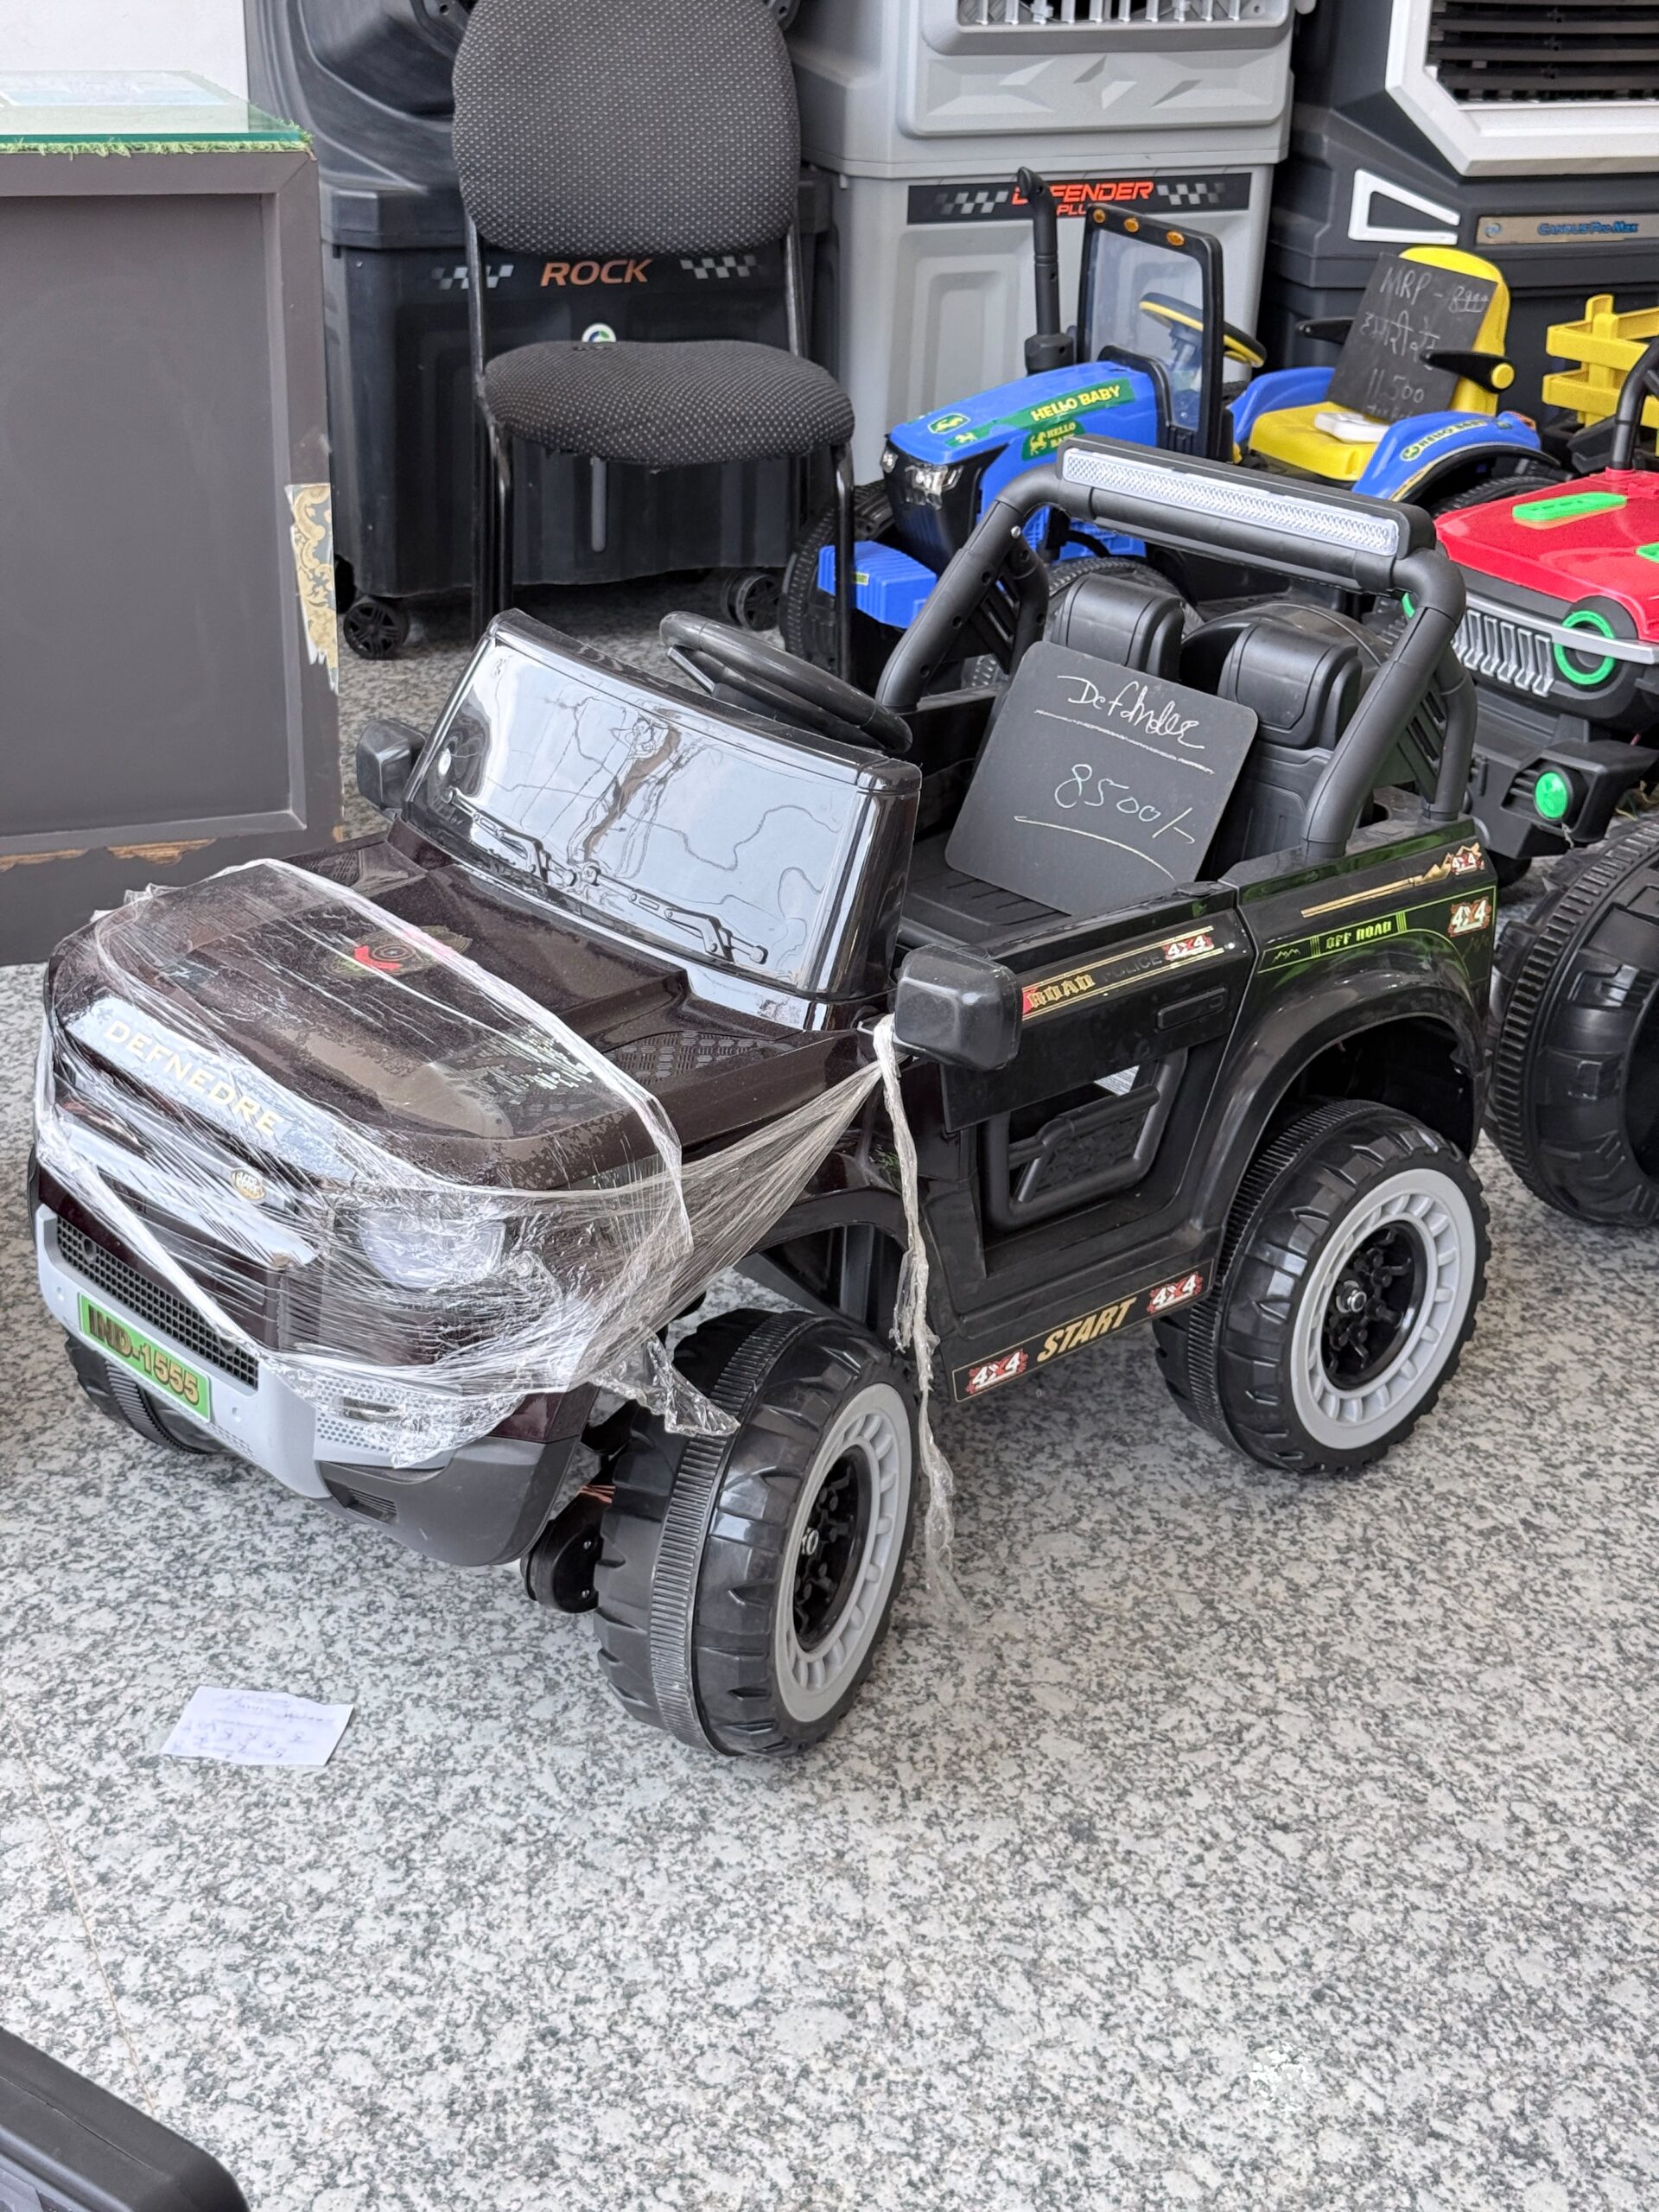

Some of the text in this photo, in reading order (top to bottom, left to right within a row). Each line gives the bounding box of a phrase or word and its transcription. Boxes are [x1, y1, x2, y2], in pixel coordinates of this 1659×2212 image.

[1011, 181, 1154, 205] FENDER
[1057, 203, 1089, 216] PLU
[540, 259, 652, 287] ROCK
[1380, 266, 1432, 305] MRP
[1030, 385, 1121, 422] HELLO BABY
[1047, 422, 1077, 439] HELLO
[1325, 920, 1392, 950] OFF ROAD
[1027, 973, 1096, 1009] ROAD
[105, 1020, 285, 1137] DEFNEDRE
[1036, 1297, 1138, 1363] START
[88, 1304, 200, 1406] IND-1555
